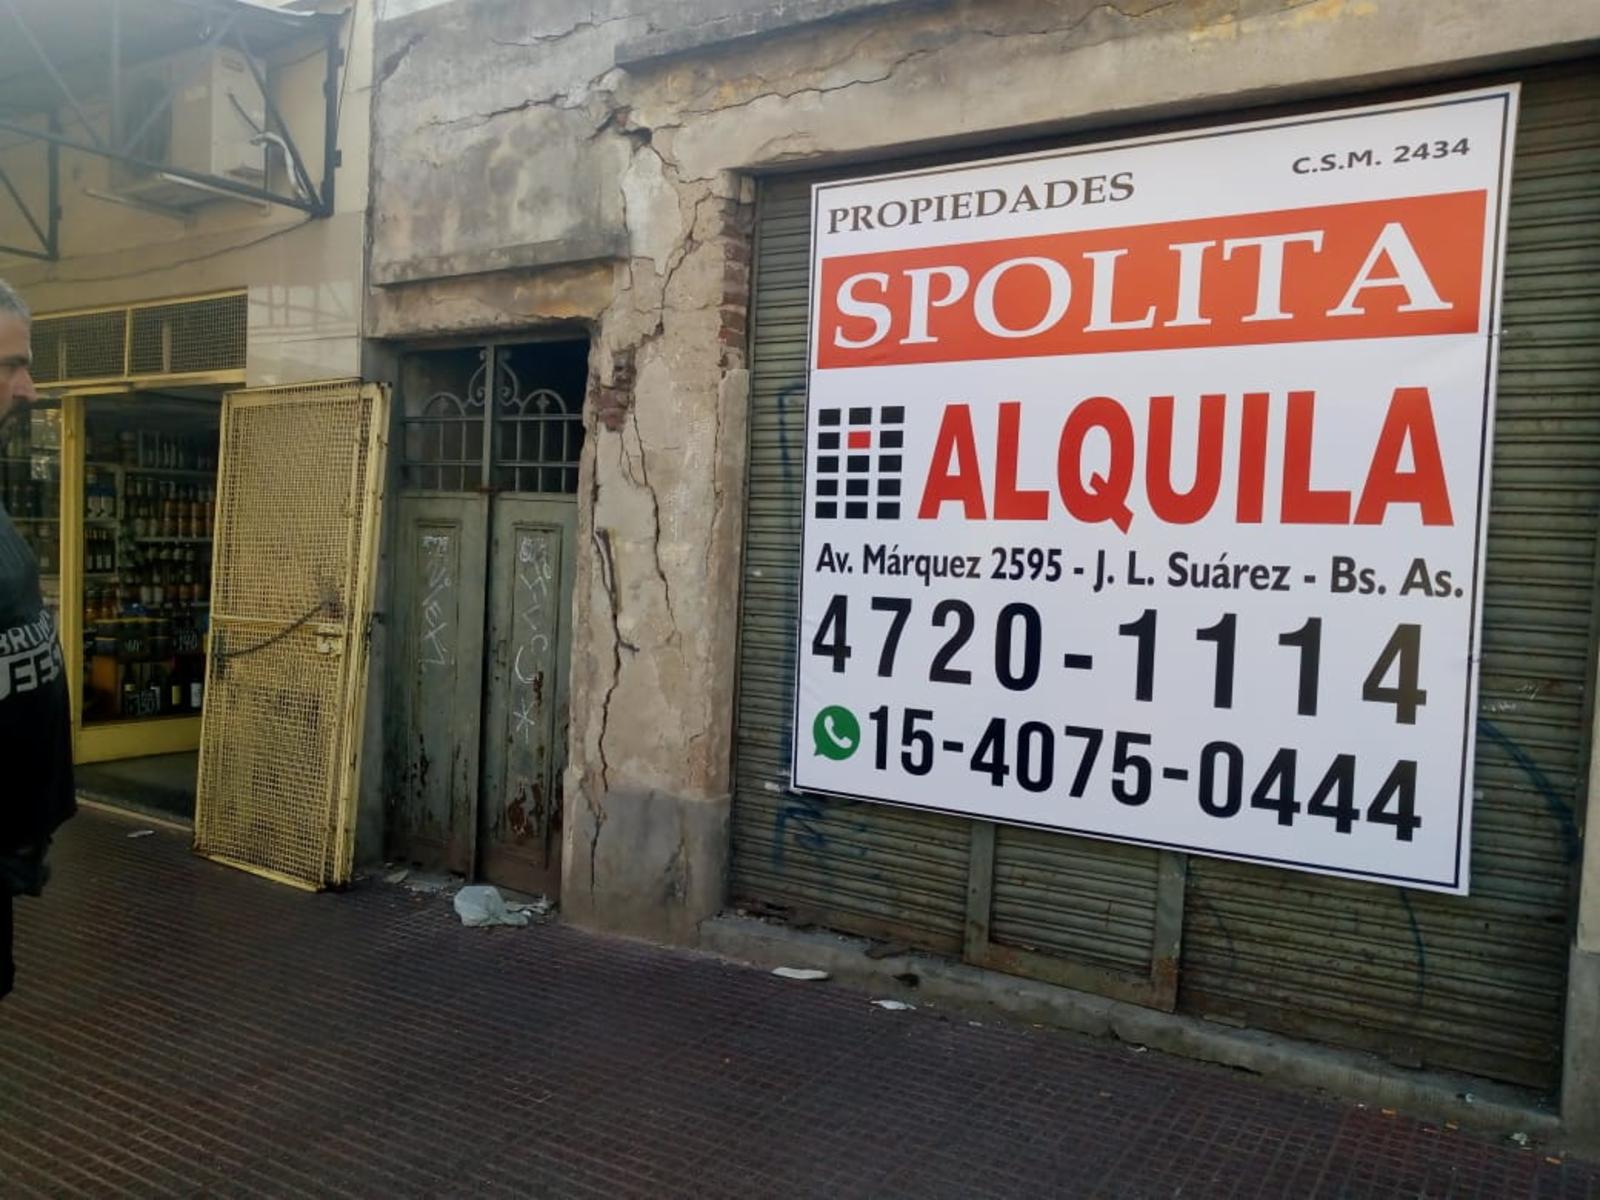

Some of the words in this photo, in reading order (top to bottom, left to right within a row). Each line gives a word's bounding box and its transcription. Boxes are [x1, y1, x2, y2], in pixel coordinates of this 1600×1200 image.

[826, 172, 1135, 234] PROPIEDADES
[1292, 149, 1382, 175] C.S.M.
[1393, 138, 1471, 163] 2434
[833, 221, 1454, 349] SPOLITA
[918, 387, 1453, 534] ALQUILA
[815, 542, 854, 575] Av.
[862, 543, 982, 588] Márquez
[990, 546, 1063, 583] 2595
[1092, 549, 1115, 593] J.
[1127, 550, 1155, 586] L.
[1167, 551, 1291, 592] Suárez
[1330, 555, 1387, 595] Bs.
[1399, 557, 1464, 598] As.
[811, 593, 1428, 726] 4720-1114
[868, 704, 1423, 843] 15-4075-0444
